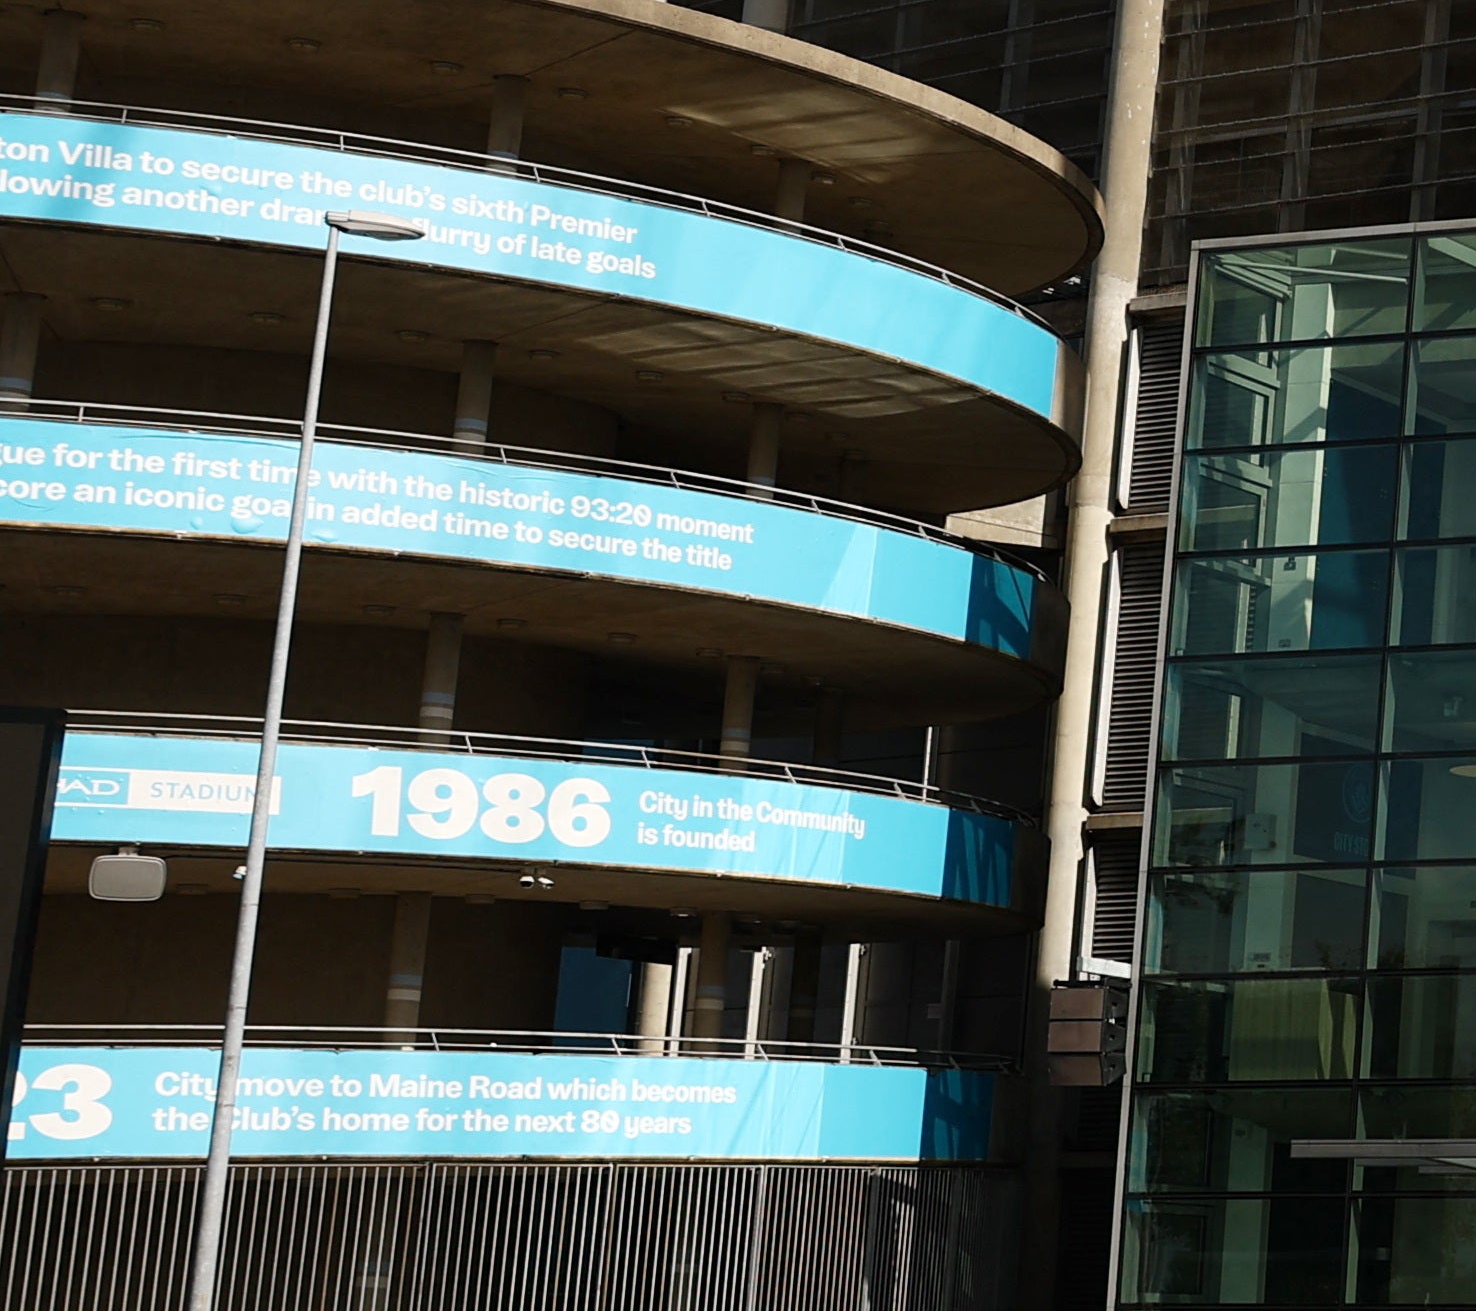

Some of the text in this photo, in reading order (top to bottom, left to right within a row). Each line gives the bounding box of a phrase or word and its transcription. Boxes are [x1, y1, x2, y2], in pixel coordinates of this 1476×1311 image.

[58, 140, 134, 172] Villa
[139, 152, 175, 175] to
[182, 160, 295, 190] secure
[300, 171, 352, 197] the
[451, 194, 524, 224] sixth
[530, 204, 638, 243] Premier
[121, 187, 256, 217] another
[496, 234, 656, 279] of late goals
[52, 443, 104, 469] for
[108, 448, 165, 473] the
[172, 452, 243, 480] first
[328, 469, 398, 495] with
[403, 475, 453, 501] the
[459, 480, 565, 515] historic
[571, 495, 653, 527] 93:20
[656, 513, 754, 544] moment
[73, 481, 732, 570] an iconic goa in added time to secure the title
[351, 766, 611, 847] 1986
[639, 790, 865, 839] City in the Community
[637, 822, 756, 853] is founded
[235, 1075, 324, 1097] move
[330, 1075, 362, 1097] to
[369, 1074, 463, 1098] Maine
[469, 1076, 542, 1099] Road
[547, 1078, 628, 1101] which
[631, 1079, 737, 1103] becomes
[152, 1106, 210, 1131] the
[323, 1107, 410, 1131] home
[415, 1108, 458, 1131] for
[462, 1109, 509, 1132] the
[515, 1112, 576, 1132] next
[581, 1110, 620, 1133] 80
[624, 1116, 692, 1139] years
